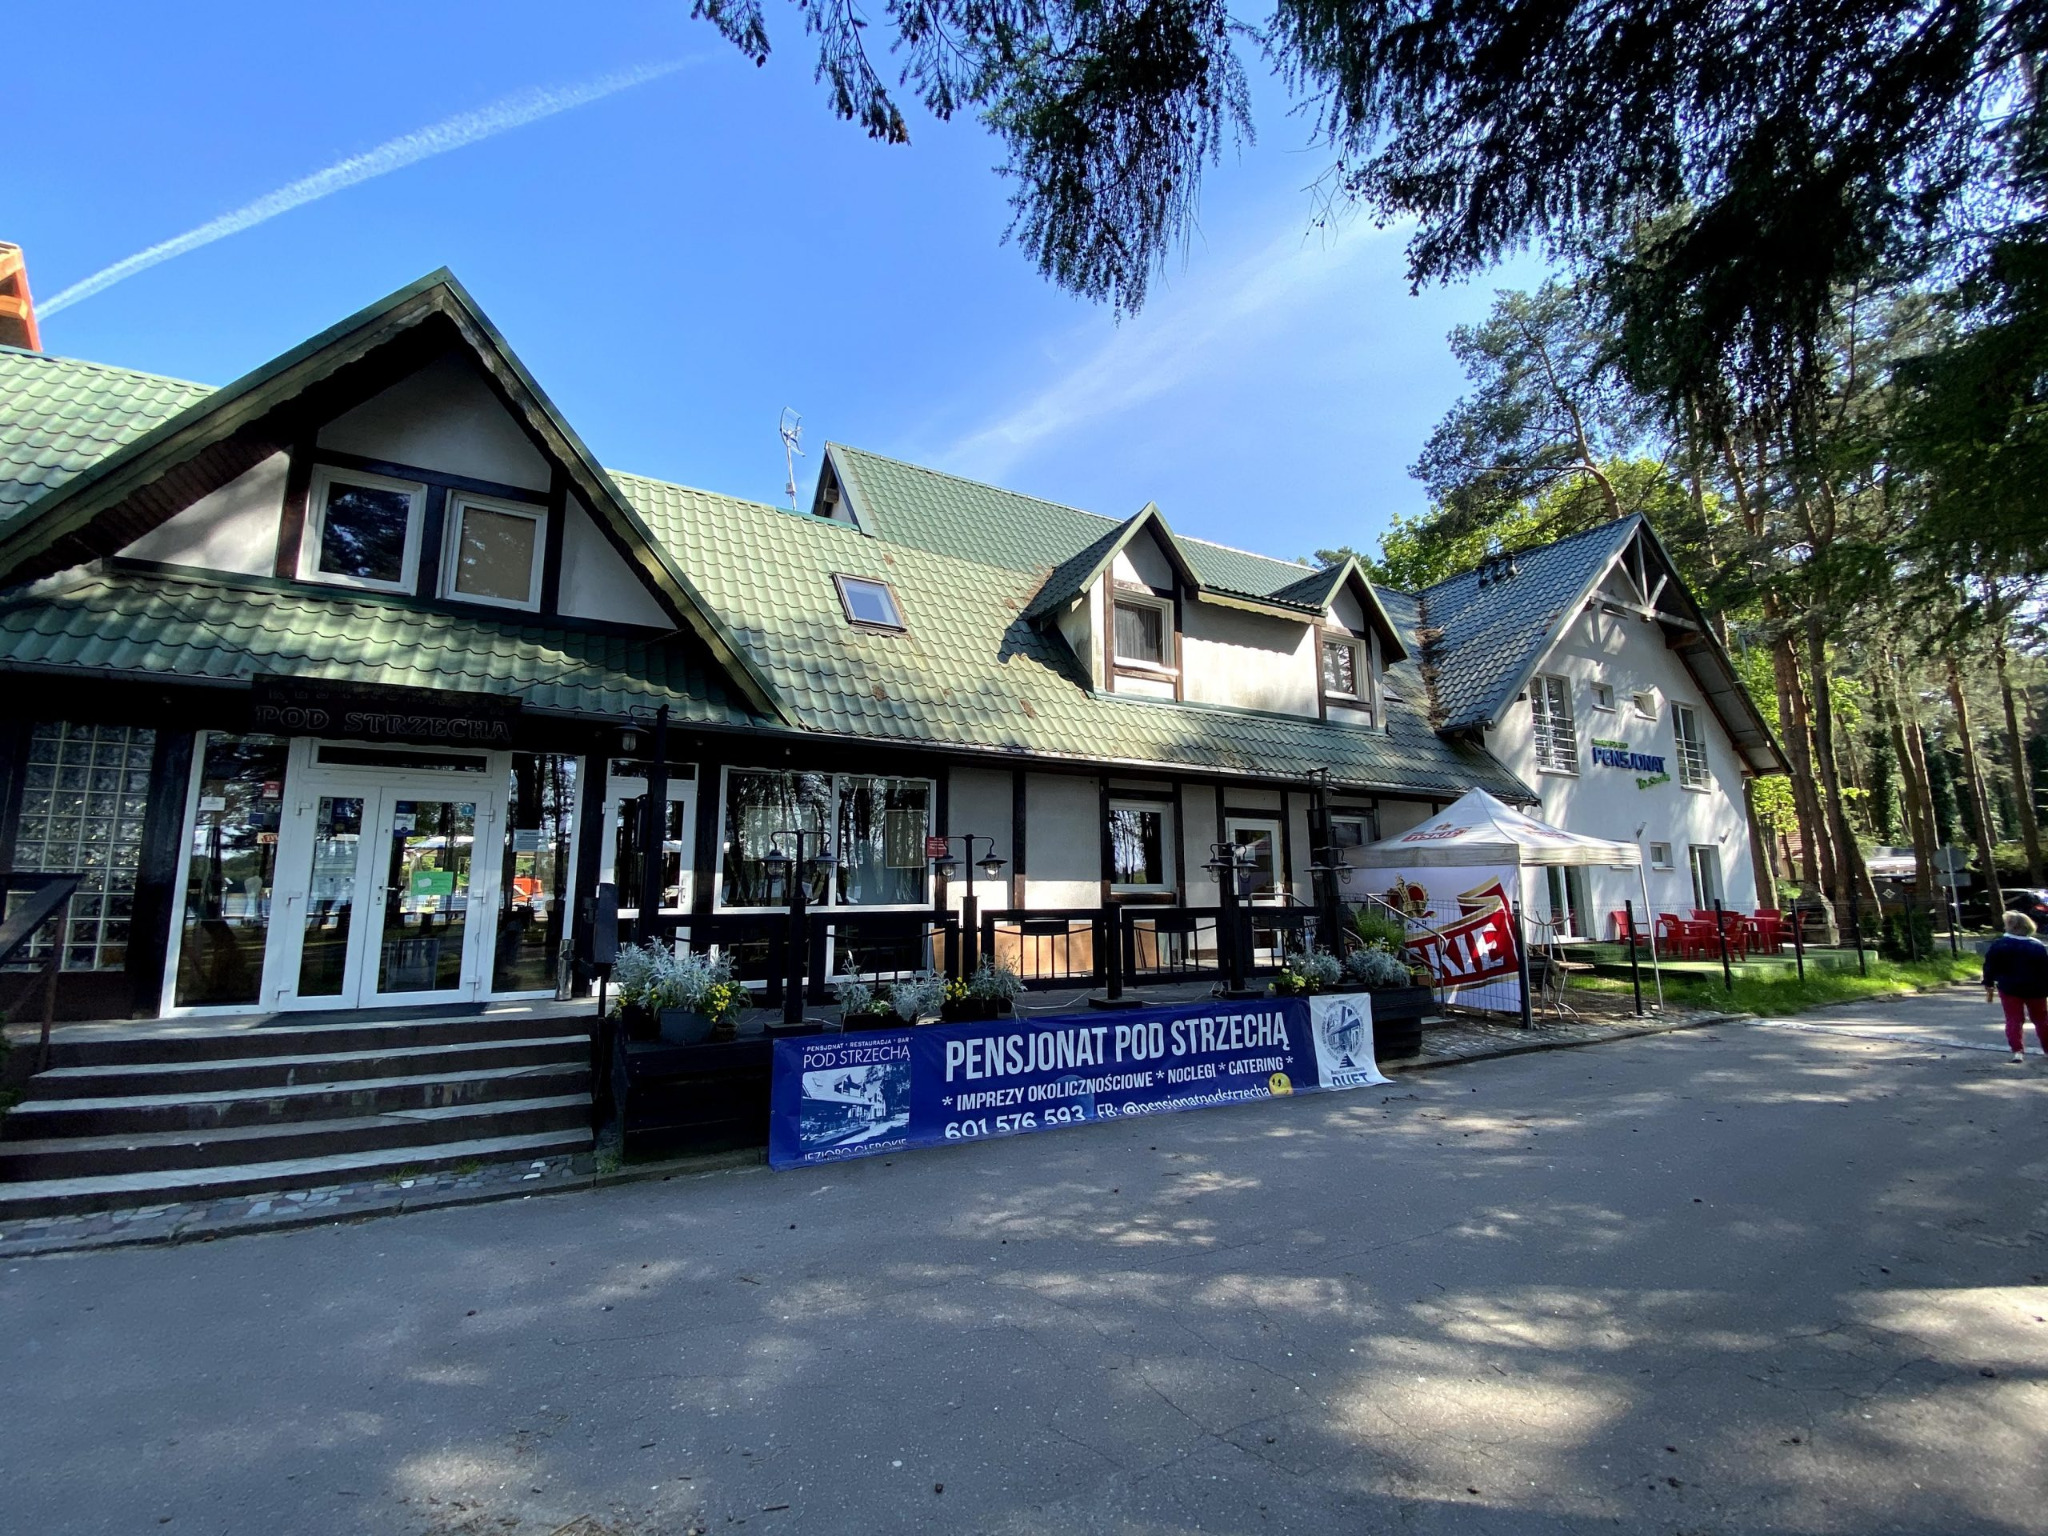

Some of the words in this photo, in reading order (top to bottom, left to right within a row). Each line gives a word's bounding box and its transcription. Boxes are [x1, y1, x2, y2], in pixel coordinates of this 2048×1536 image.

[255, 704, 330, 731] POD
[1592, 747, 1666, 773] PENSJONAT
[803, 1052, 836, 1069] POD
[839, 1045, 911, 1065] STRZECHĄ
[806, 1043, 844, 1052] PENSJONAT
[849, 1039, 892, 1048] RESTAURACJA
[946, 1026, 1108, 1082] PENSJONAT
[1115, 1022, 1164, 1062] POD
[1170, 1011, 1291, 1056] STRZECHĄ
[957, 1087, 1024, 1111] IMPREZY
[1028, 1071, 1154, 1102] OKOLICZNOŚCIOWE
[1167, 1063, 1216, 1085] NOCLEGI
[1228, 1056, 1284, 1076] CATERING
[944, 1118, 989, 1140] 601
[996, 1112, 1037, 1133] 576
[1044, 1105, 1085, 1125] 593
